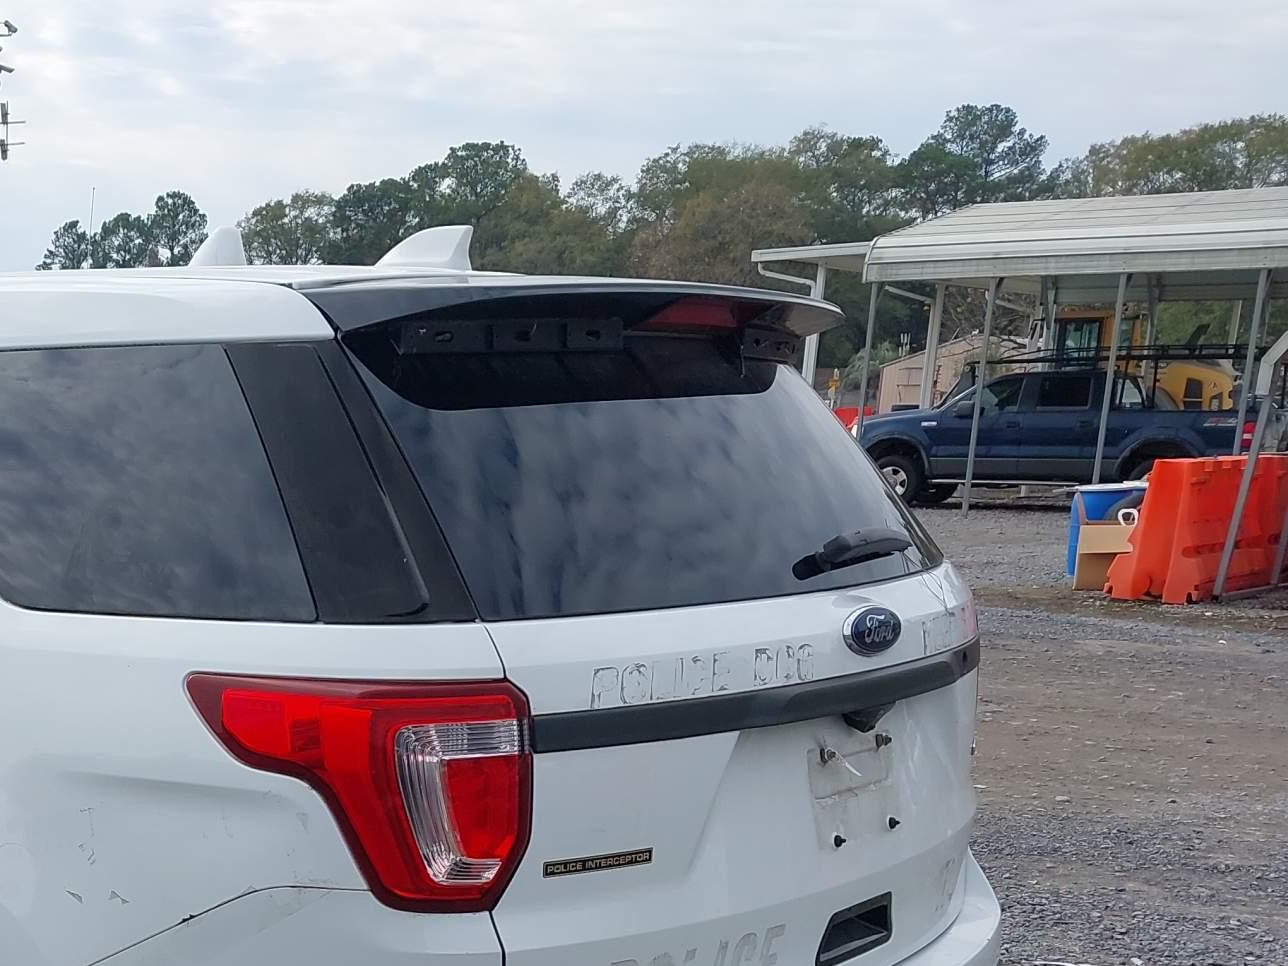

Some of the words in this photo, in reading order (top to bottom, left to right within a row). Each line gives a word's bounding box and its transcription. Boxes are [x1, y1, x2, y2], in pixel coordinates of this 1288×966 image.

[864, 614, 896, 643] Ford
[546, 863, 583, 874] POLICE
[585, 852, 650, 869] INTERCEPTOR
